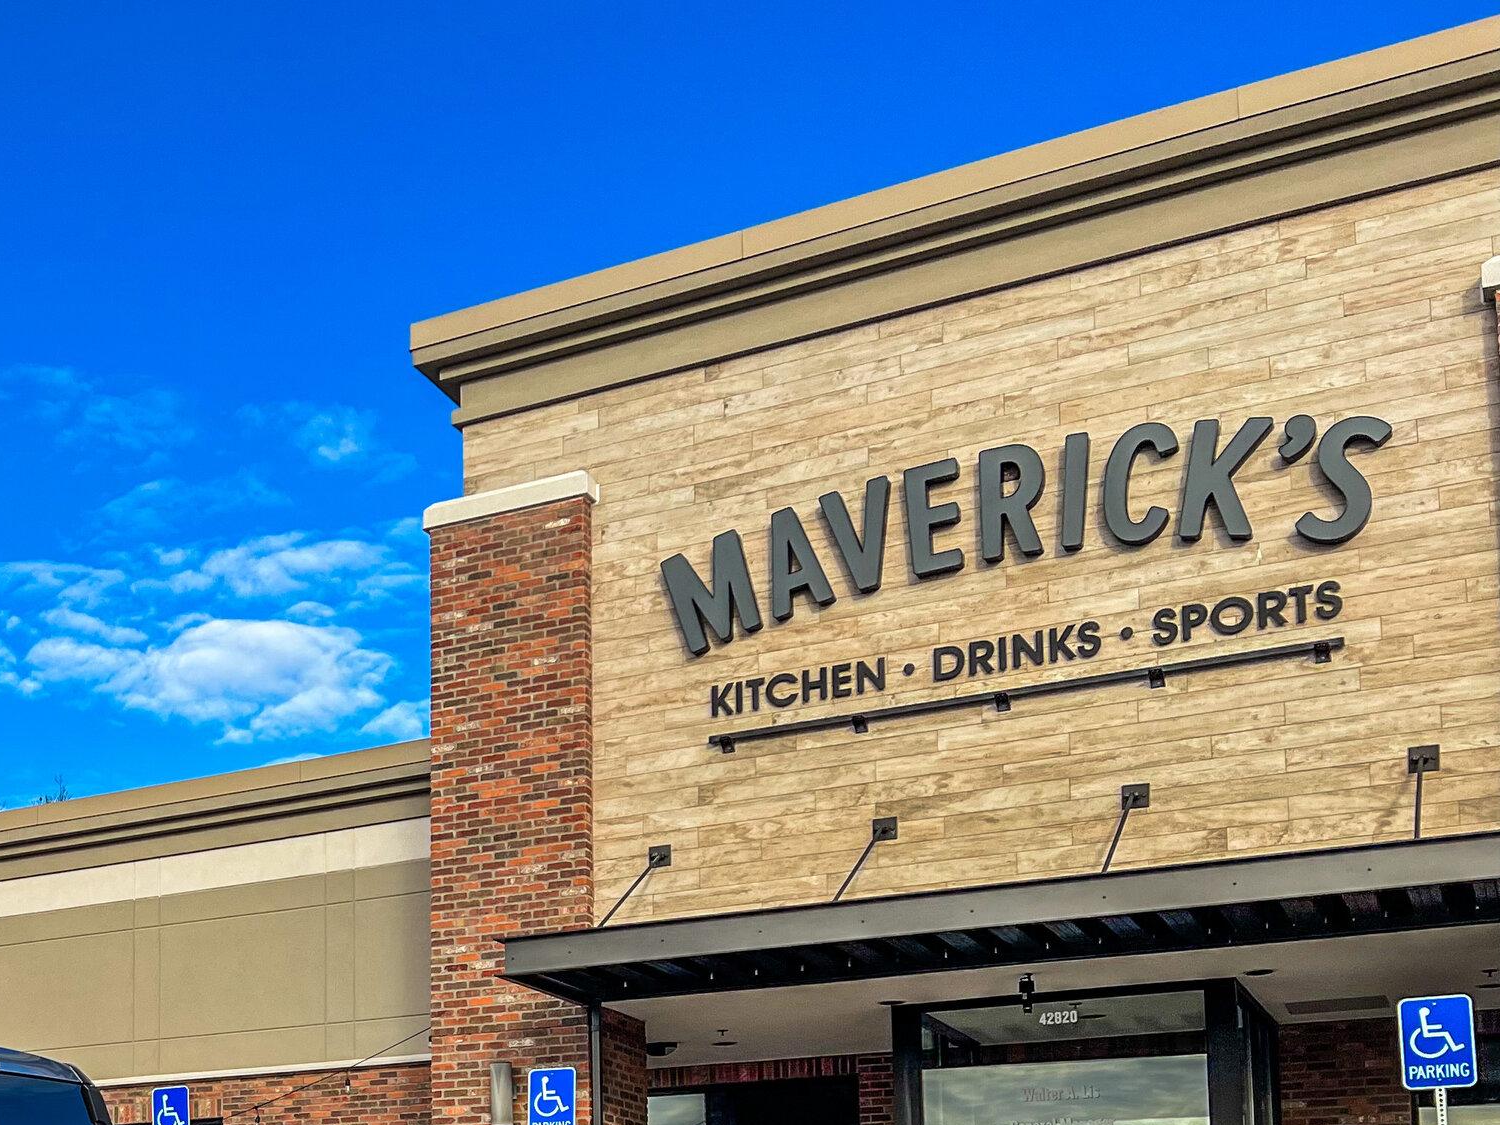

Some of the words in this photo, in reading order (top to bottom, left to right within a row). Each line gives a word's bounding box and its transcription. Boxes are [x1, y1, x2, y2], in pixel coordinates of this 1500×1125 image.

[660, 414, 1393, 658] MAVERICK'S
[709, 656, 886, 718] KITCHEN
[931, 620, 1101, 682] DRINKS
[1151, 580, 1343, 647] SPORTS
[1038, 1010, 1078, 1025] 42820
[1408, 1062, 1470, 1080] PARKING
